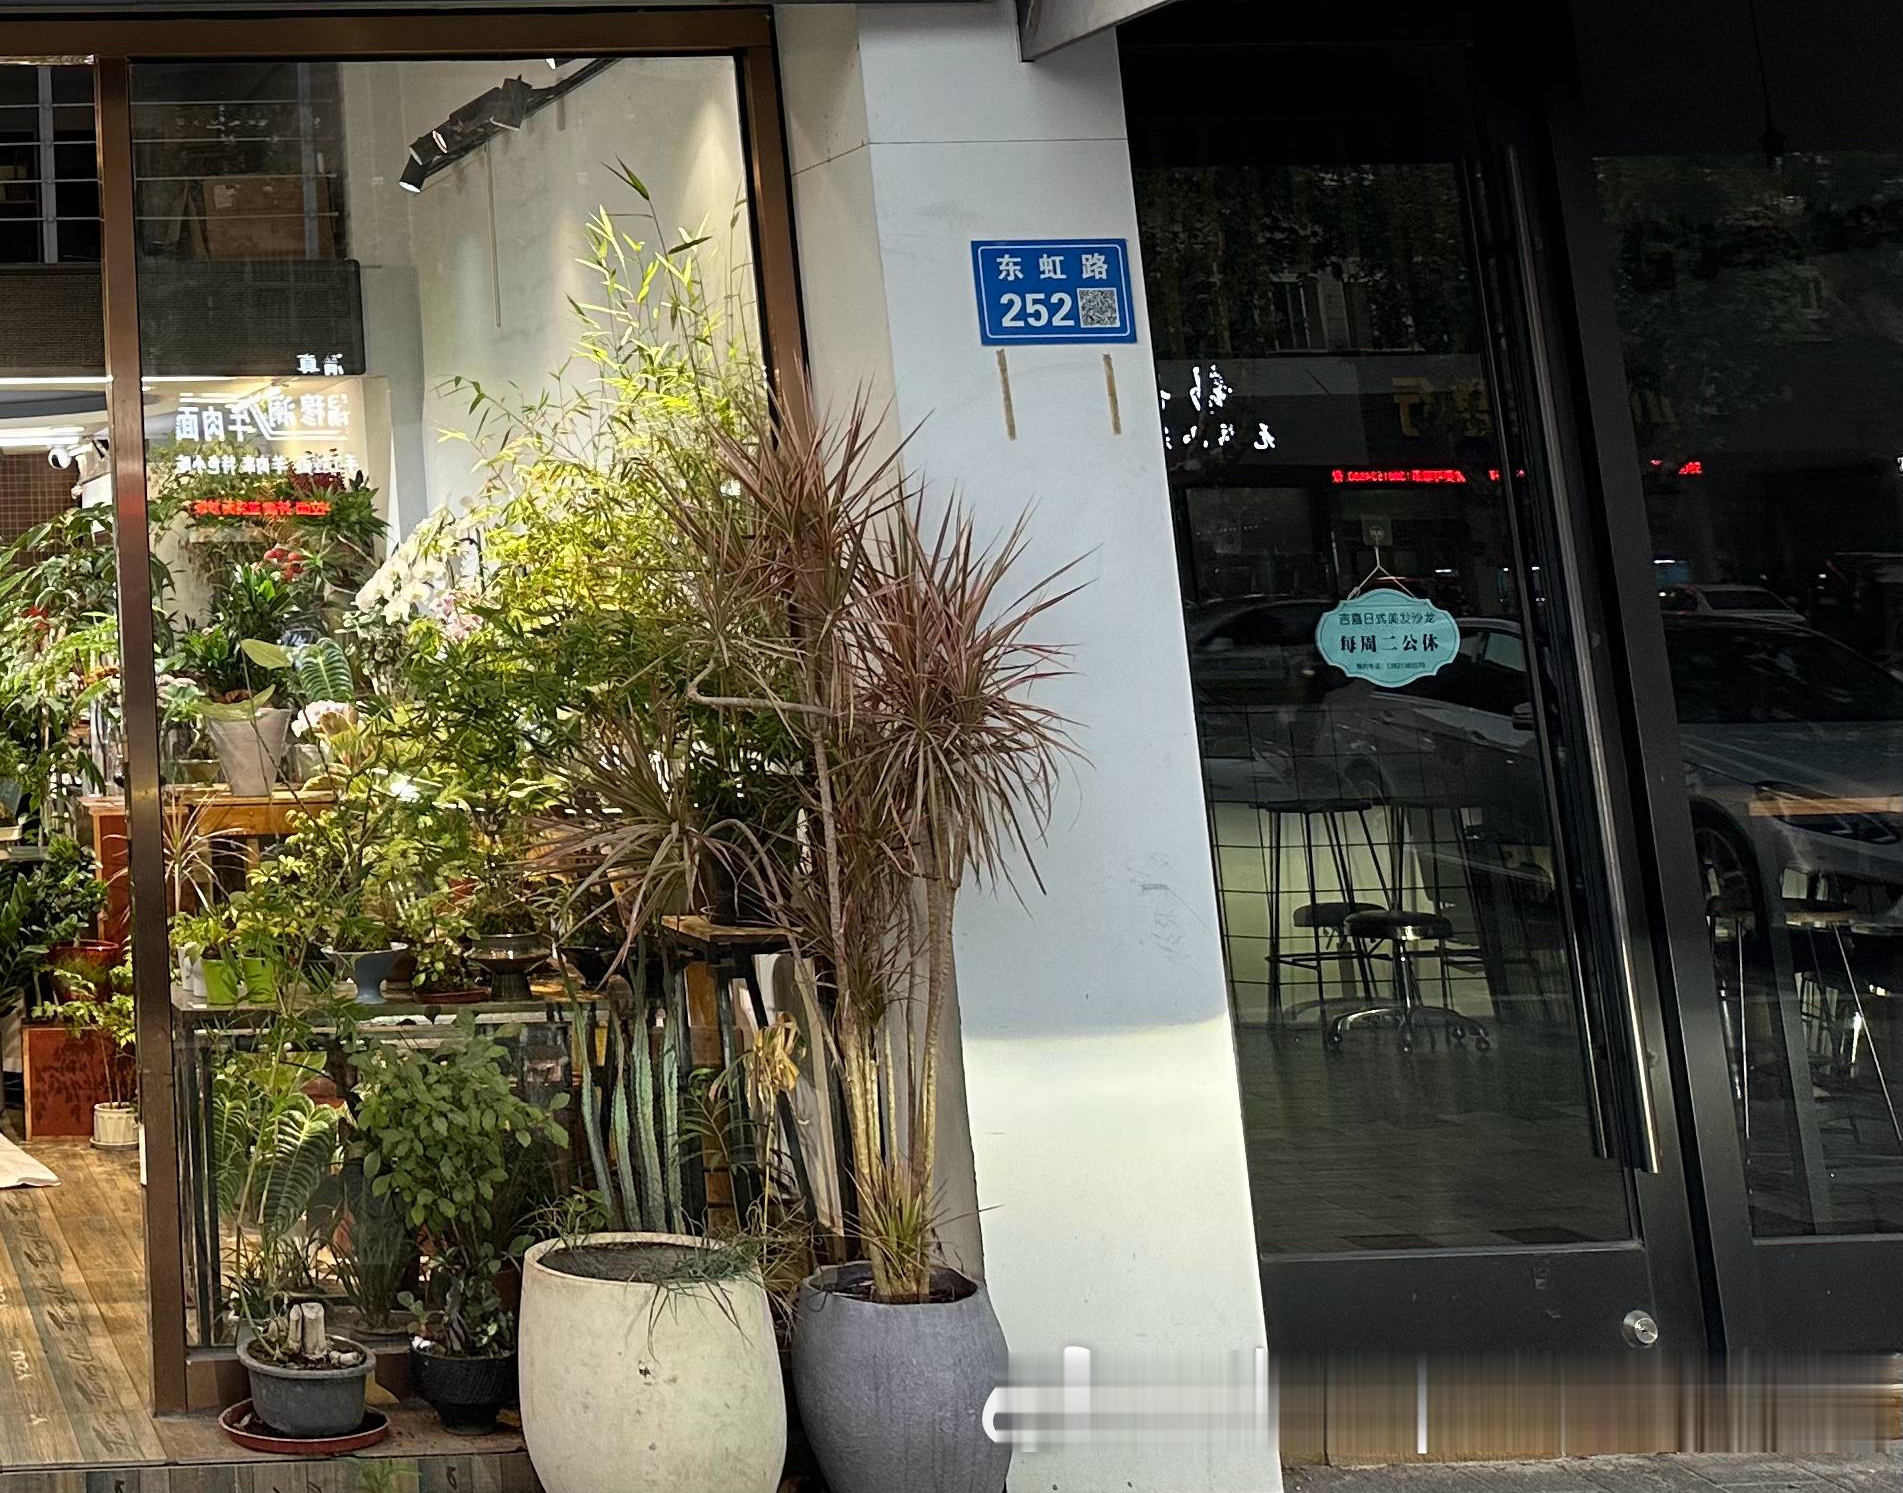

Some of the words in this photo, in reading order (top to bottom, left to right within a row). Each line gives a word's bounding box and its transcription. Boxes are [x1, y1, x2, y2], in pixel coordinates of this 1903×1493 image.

[997, 253, 1109, 281] 东虹路
[999, 292, 1075, 327] 252
[1340, 633, 1439, 654] 每周二公休
